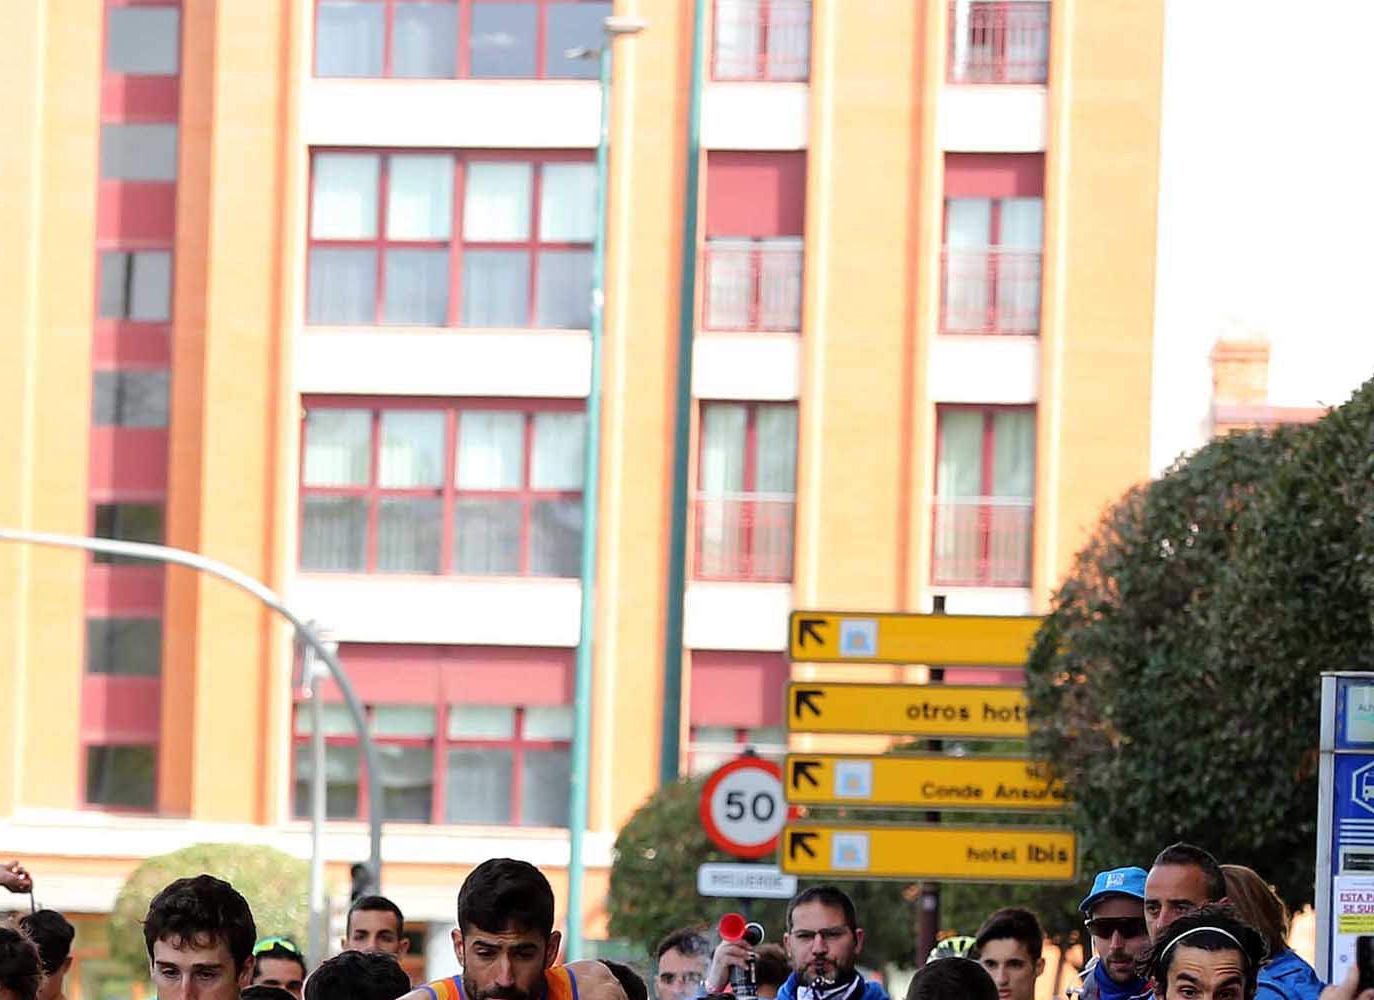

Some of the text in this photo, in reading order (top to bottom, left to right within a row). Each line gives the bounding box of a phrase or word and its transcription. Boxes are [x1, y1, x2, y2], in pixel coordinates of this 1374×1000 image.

[906, 702, 969, 721] otros
[921, 784, 984, 801] Conde
[726, 791, 775, 823] 50
[967, 845, 1068, 864] hotel Ibis
